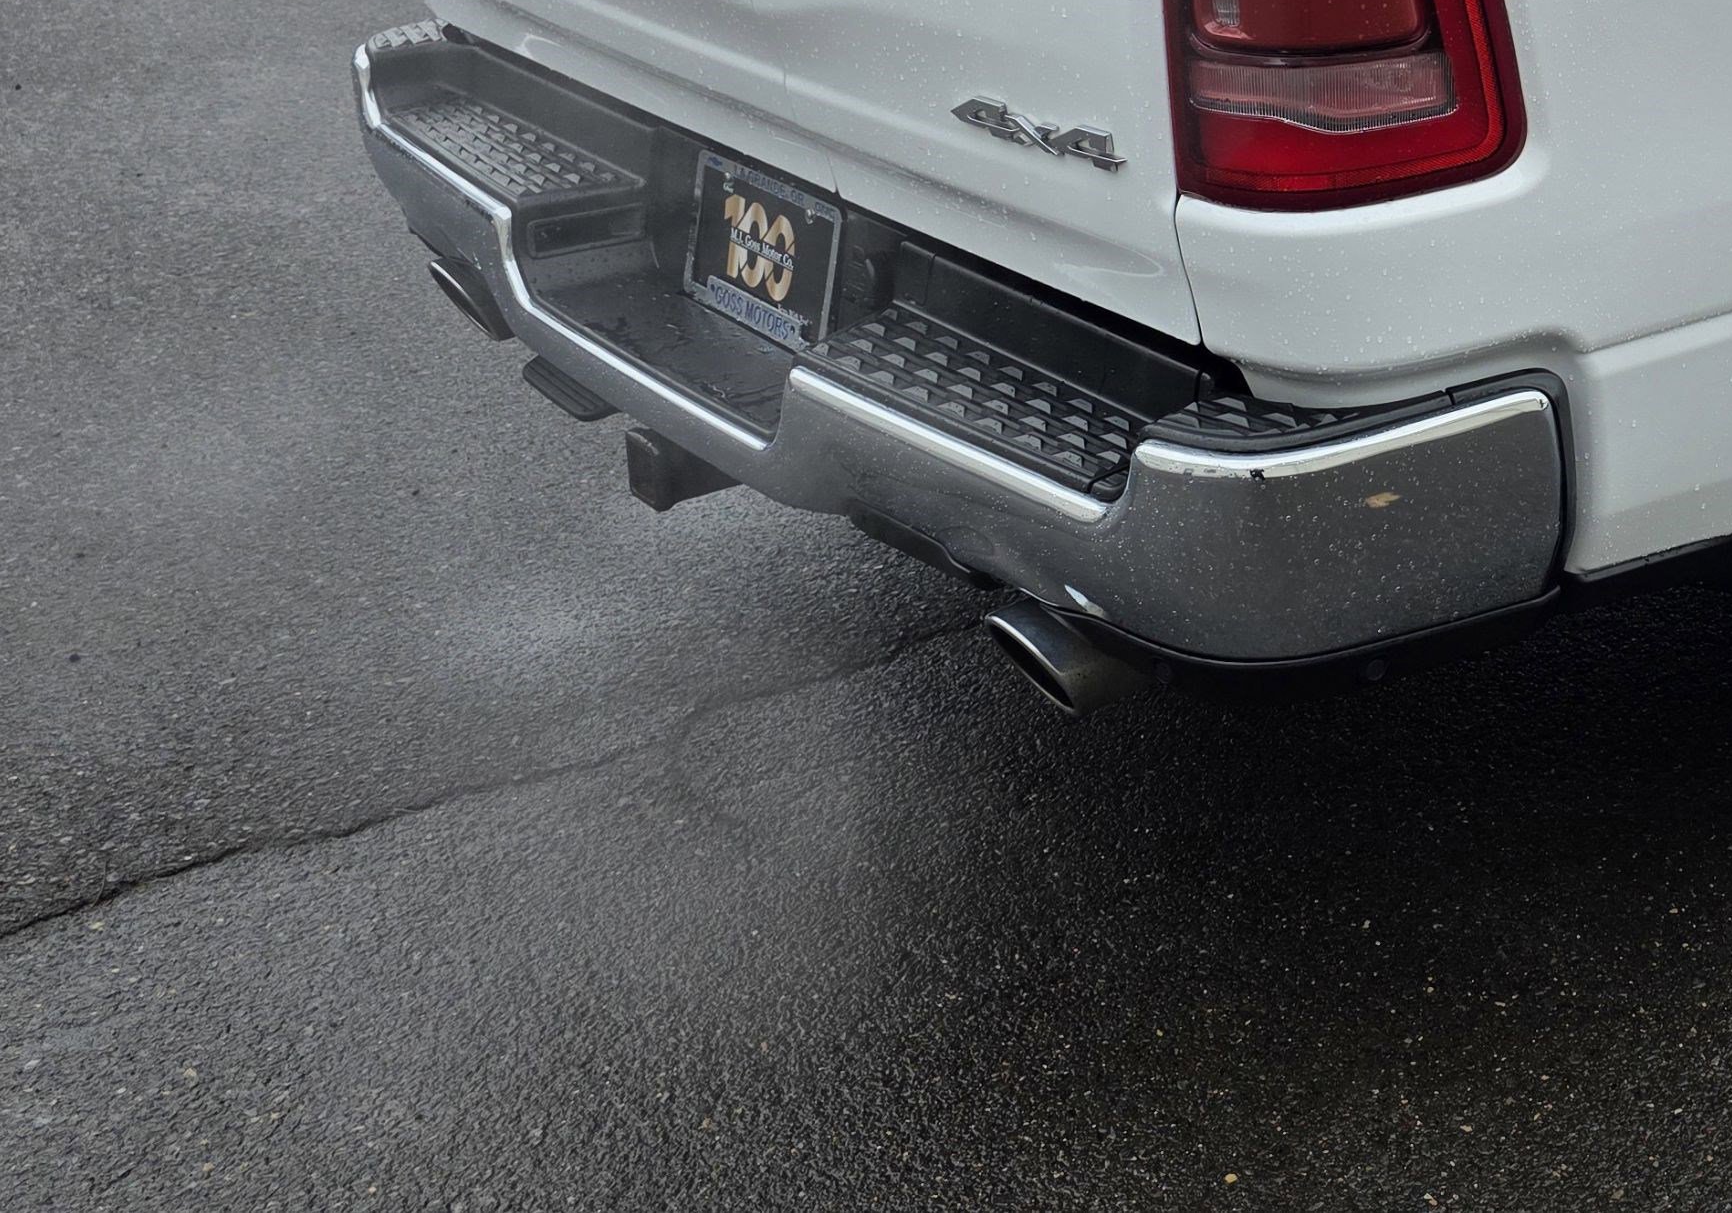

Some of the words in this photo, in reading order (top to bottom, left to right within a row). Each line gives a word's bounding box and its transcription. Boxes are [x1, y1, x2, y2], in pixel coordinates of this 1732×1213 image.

[724, 194, 796, 302] 100
[715, 286, 744, 316] GOSS
[744, 300, 790, 340] MOTORS
